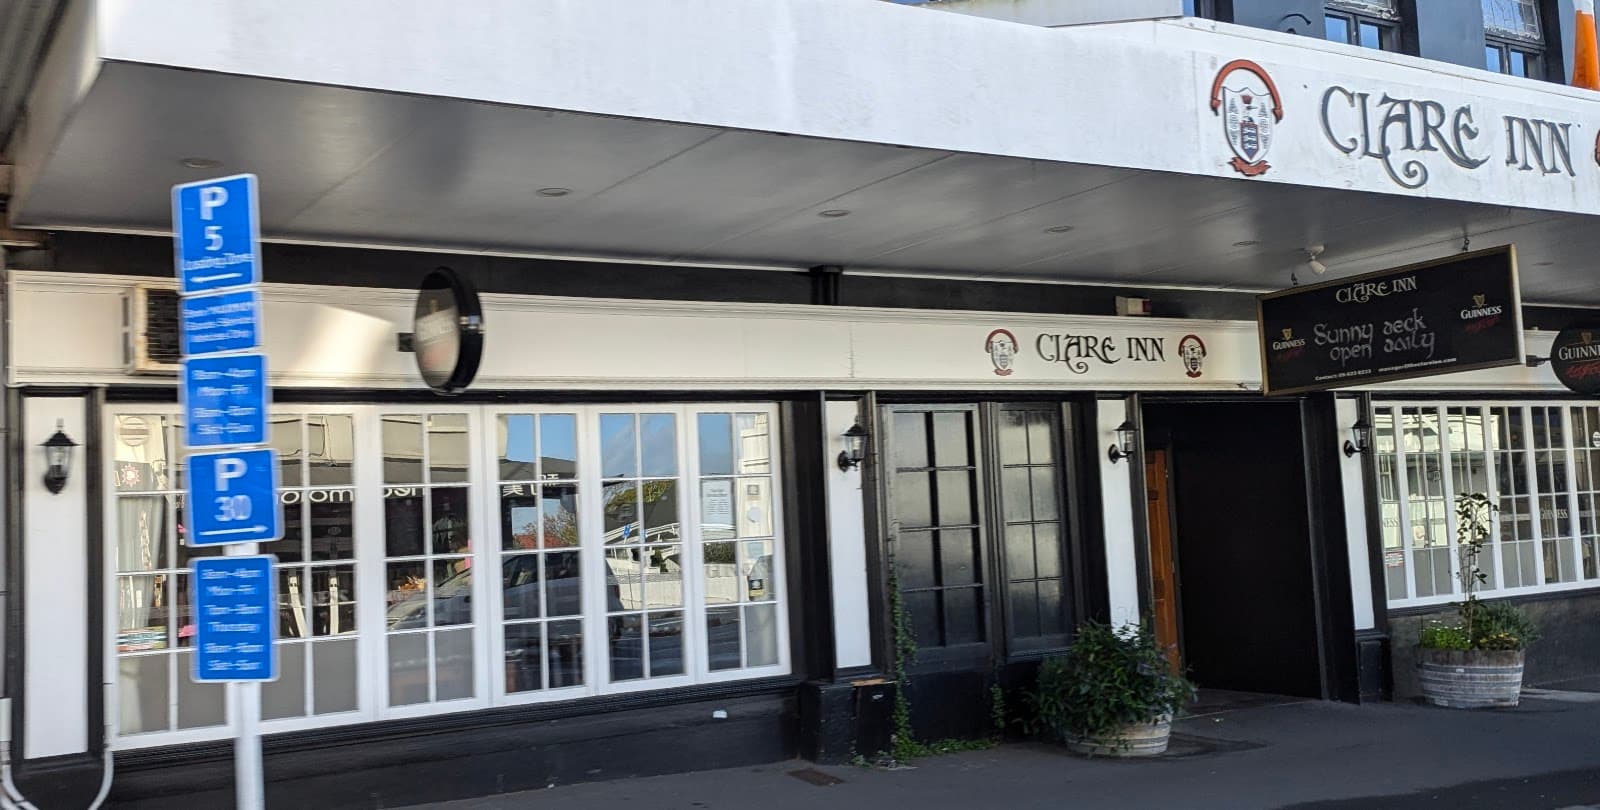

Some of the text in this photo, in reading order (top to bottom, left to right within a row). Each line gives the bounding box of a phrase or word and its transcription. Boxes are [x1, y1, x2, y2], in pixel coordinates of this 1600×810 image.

[1321, 85, 1576, 189] CLARE INN
[199, 185, 228, 221] P
[203, 225, 224, 251] 5
[1336, 276, 1417, 303] CLARE INN
[1460, 305, 1502, 319] GUINNESS
[1313, 307, 1427, 346] Sunny deck
[1035, 333, 1166, 374] CLARE INN
[1272, 339, 1306, 351] GUINNESS
[1330, 343, 1372, 367] open
[214, 458, 248, 491] P
[214, 495, 252, 522] 30
